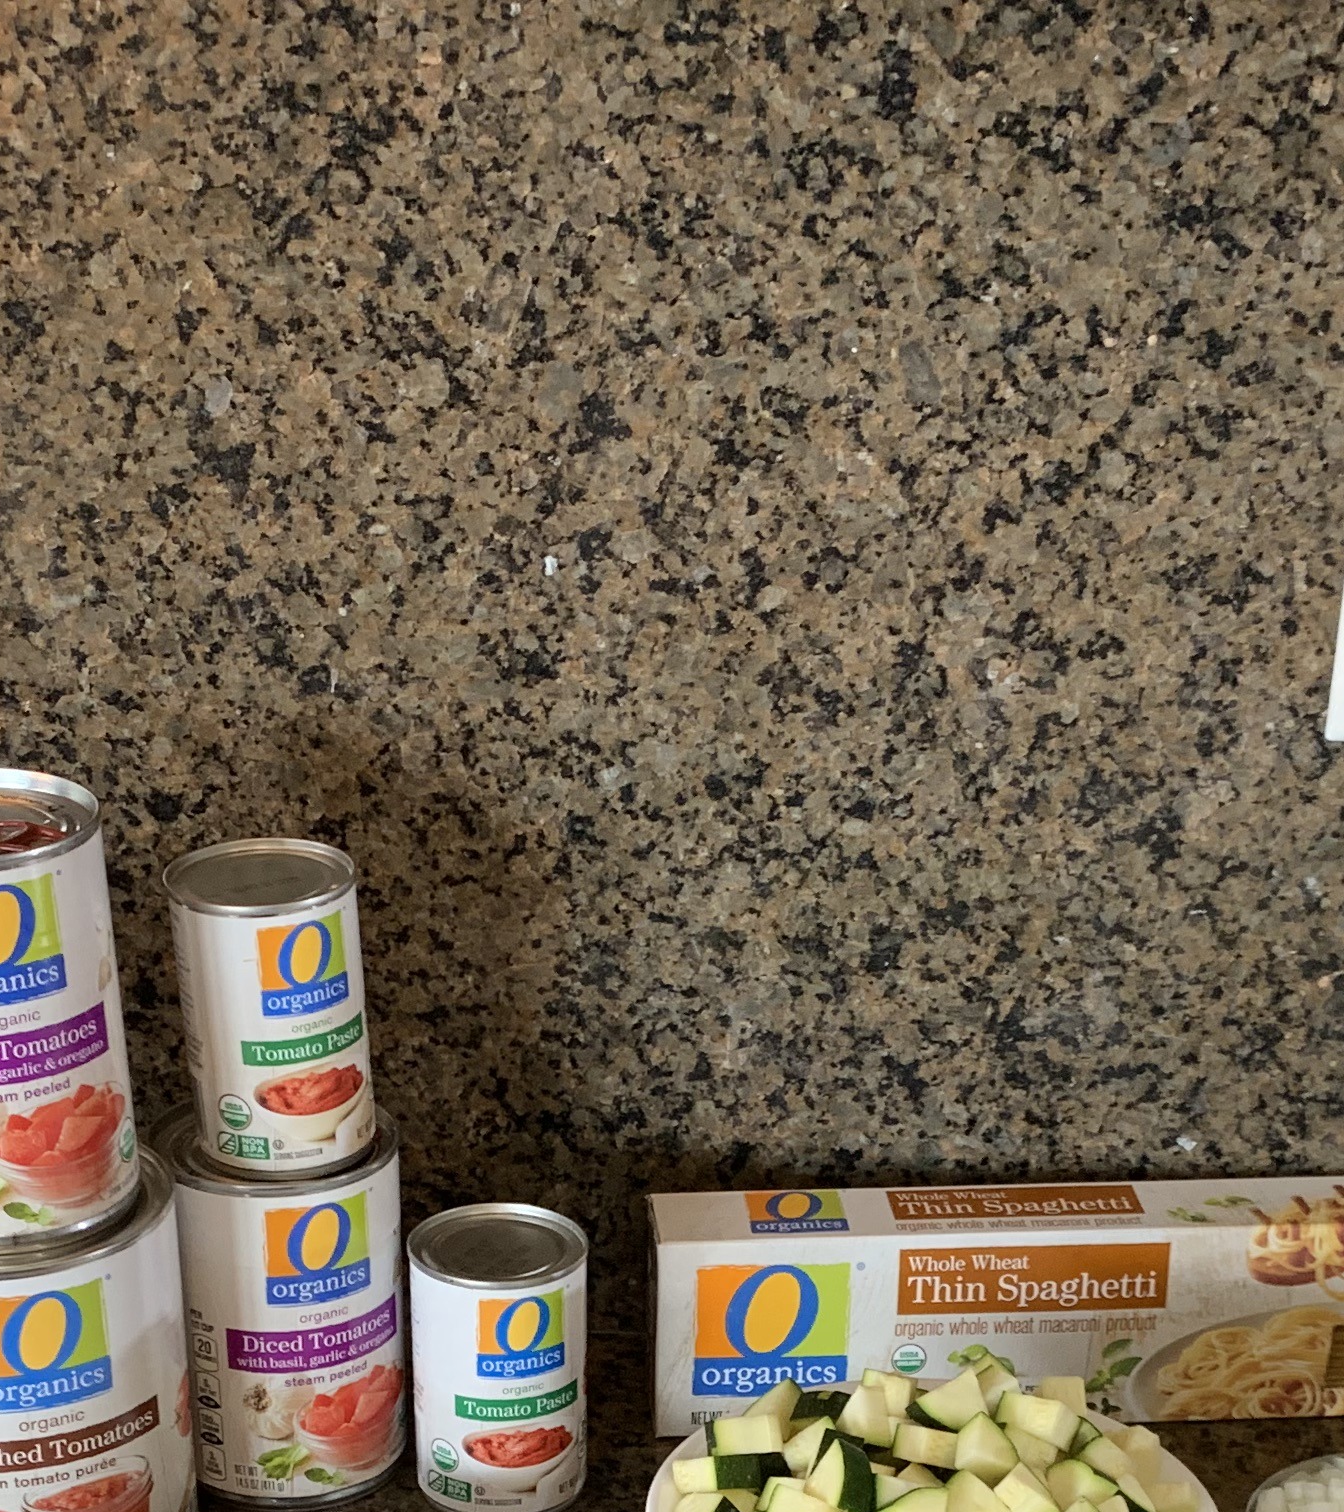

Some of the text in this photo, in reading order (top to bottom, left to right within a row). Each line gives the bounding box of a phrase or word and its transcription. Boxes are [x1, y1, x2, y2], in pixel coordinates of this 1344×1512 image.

[267, 978, 346, 1014] organics
[291, 1016, 333, 1035] organic
[43, 1056, 56, 1072] &
[57, 1036, 104, 1069] oregano
[251, 1022, 360, 1062] Tomato Paste
[22, 1076, 71, 1099] peeled
[895, 1189, 1006, 1201] Whole Wheat
[898, 1194, 1133, 1219] Thin Spaghetti
[755, 1217, 844, 1233] organics
[895, 1222, 942, 1233] organic
[946, 1219, 981, 1231] whole
[986, 1218, 1026, 1230] wheat
[1094, 1215, 1143, 1226] product
[908, 1255, 1030, 1272] Whole Wheat
[272, 1265, 366, 1302] organics
[907, 1270, 1158, 1308] Thin Spaghetti
[299, 1306, 349, 1325] organic
[894, 1314, 1158, 1340] organic whole wheat macaroni product
[242, 1308, 390, 1355] Diced Tomatoes
[197, 1338, 211, 1355] 20
[236, 1325, 394, 1371] with basil, garlic & oregano
[284, 1361, 368, 1389] steam peeled
[482, 1349, 561, 1377] organics
[502, 1383, 544, 1397] organic
[701, 1359, 837, 1397] organics
[464, 1389, 574, 1419] Tomato Paste
[19, 1409, 86, 1434] organic
[50, 1410, 154, 1460] Tomatoes
[14, 1469, 71, 1489] tomato
